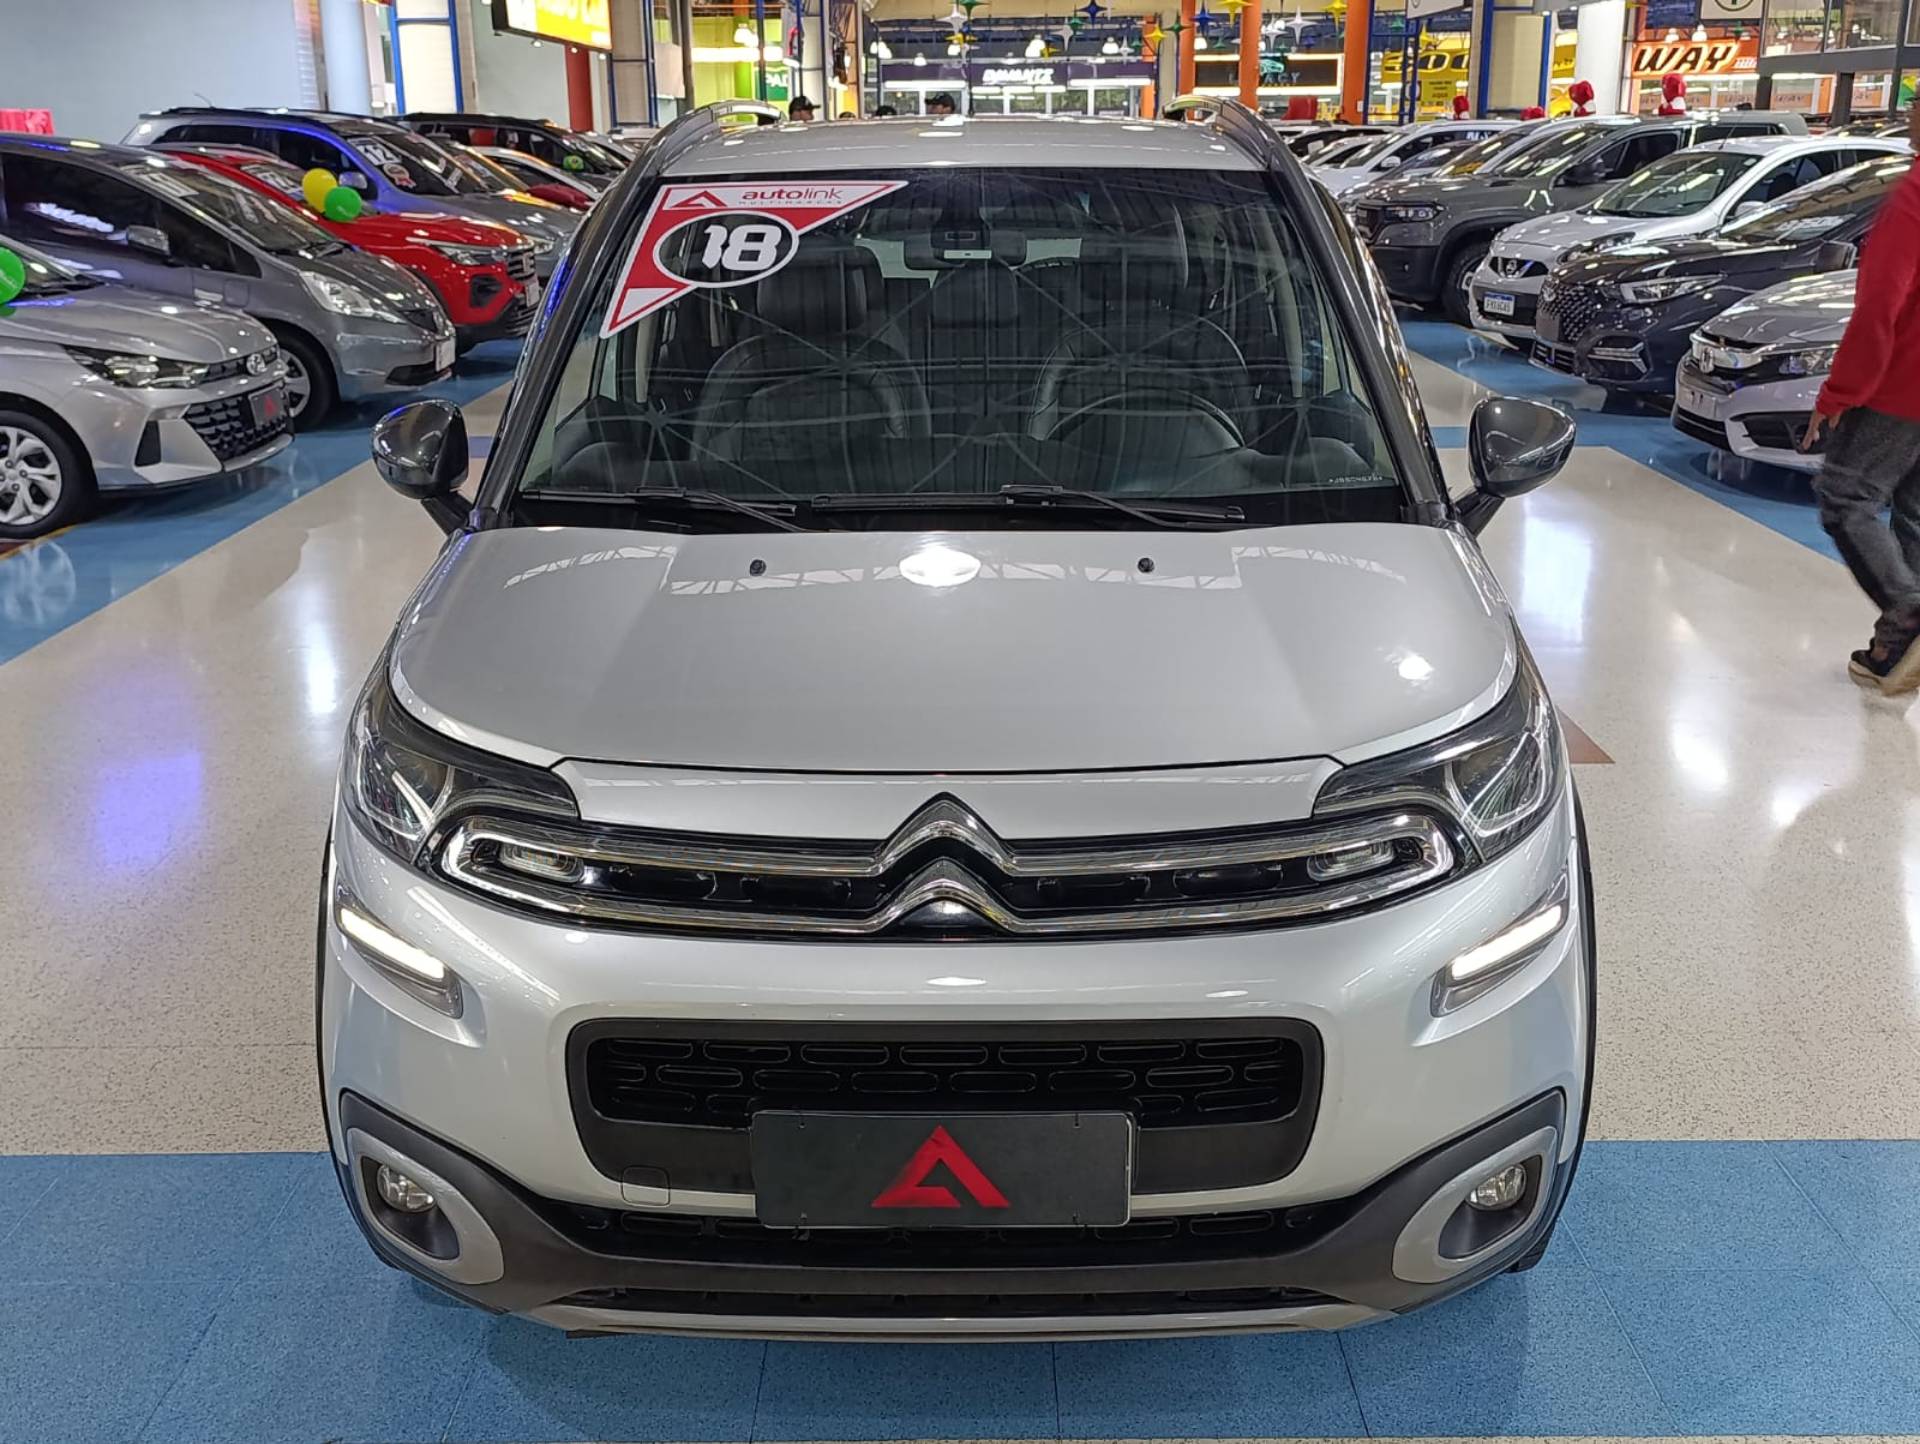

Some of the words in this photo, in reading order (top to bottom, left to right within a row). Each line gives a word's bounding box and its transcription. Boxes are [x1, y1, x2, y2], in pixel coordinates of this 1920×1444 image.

[1633, 43, 1738, 74] WAY
[1228, 72, 1301, 83] LACY
[742, 187, 843, 200] autolink
[702, 223, 782, 271] 18
